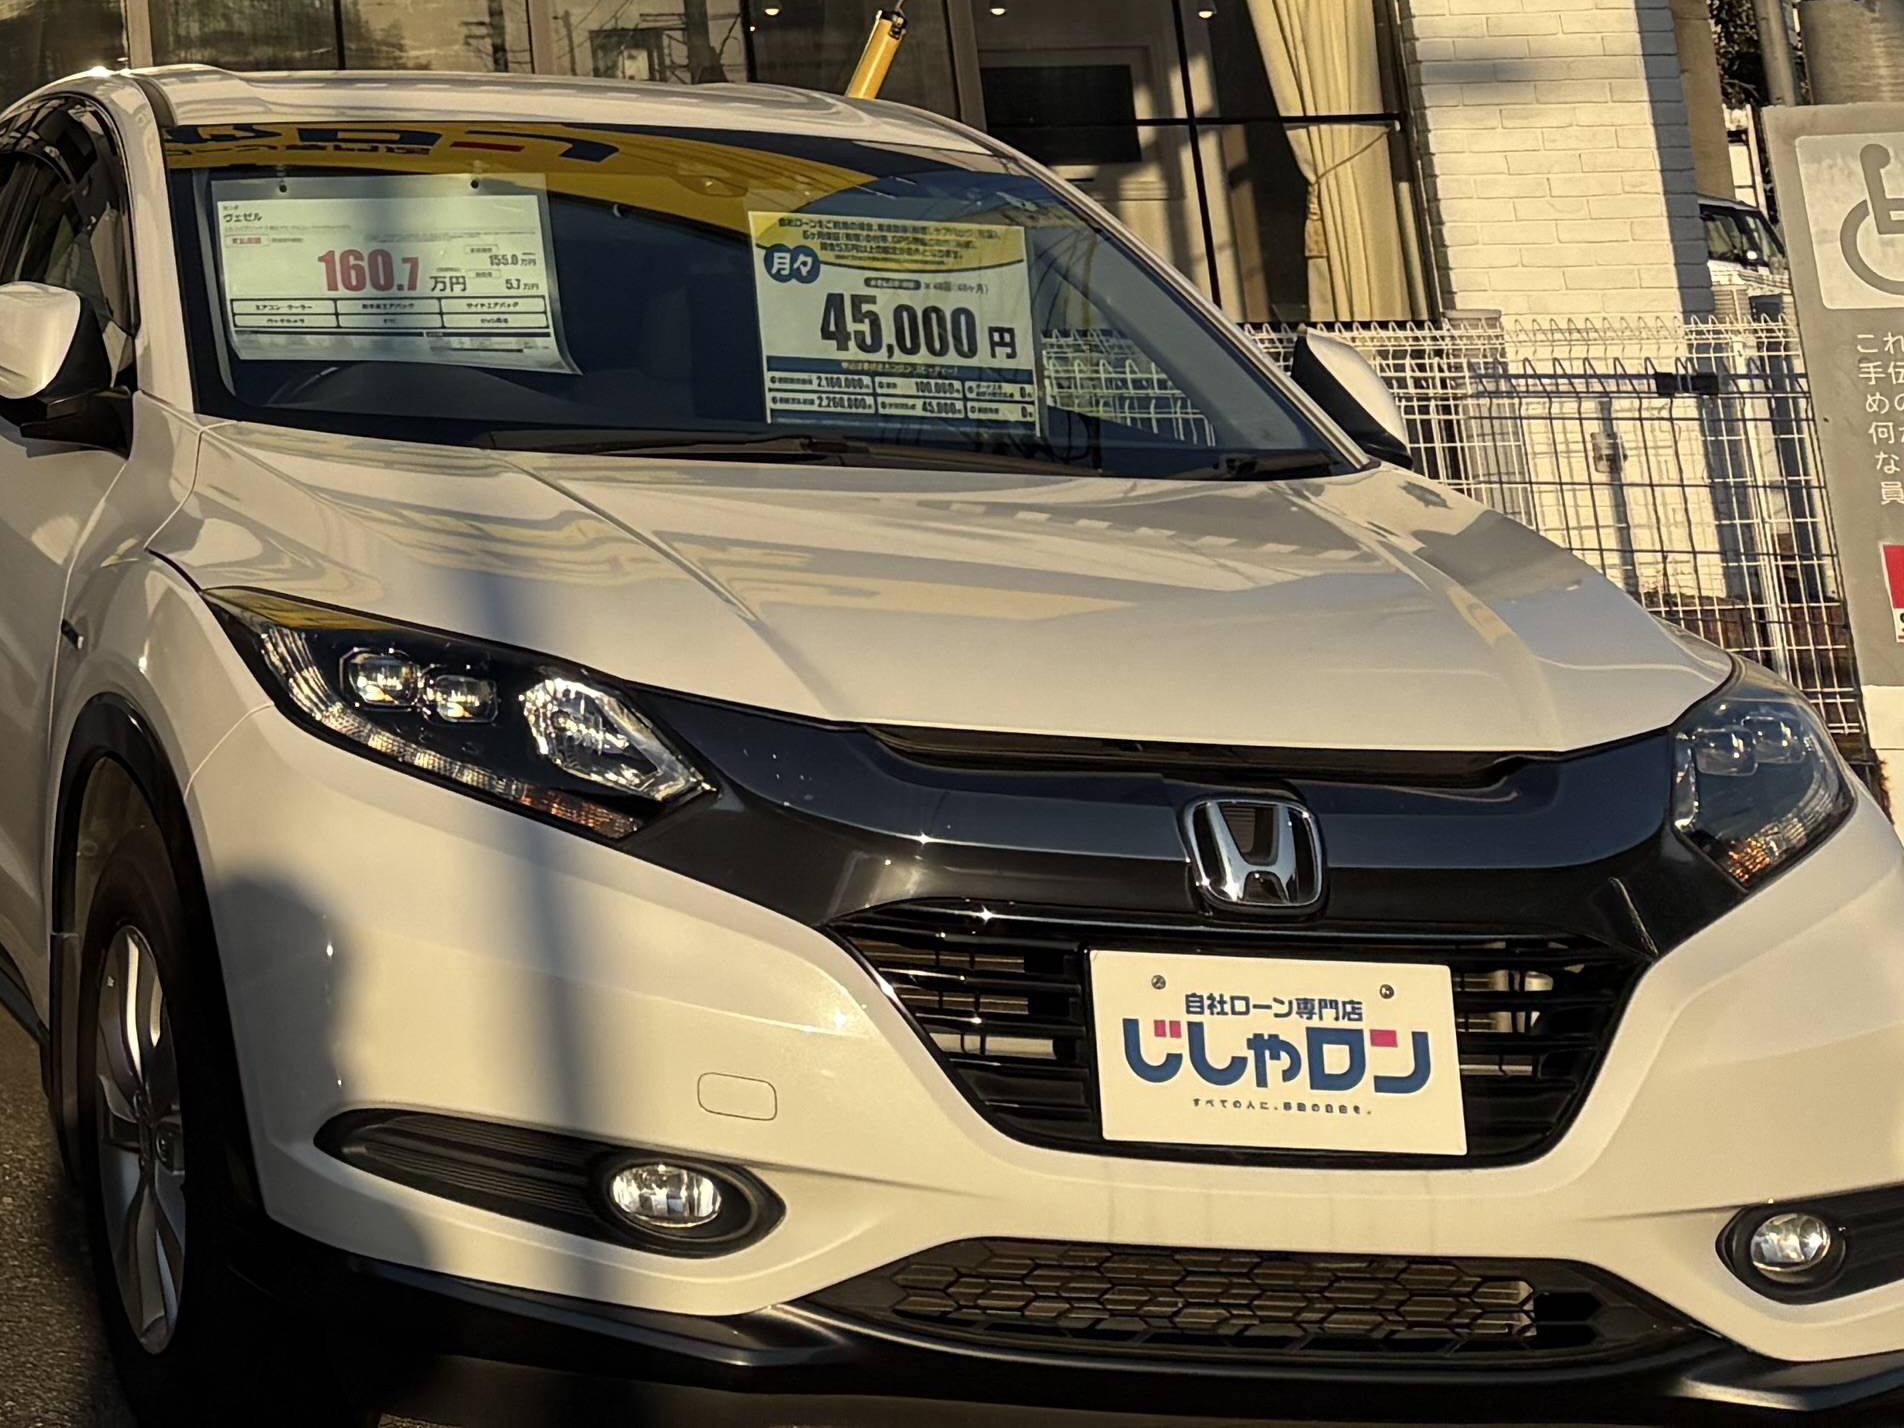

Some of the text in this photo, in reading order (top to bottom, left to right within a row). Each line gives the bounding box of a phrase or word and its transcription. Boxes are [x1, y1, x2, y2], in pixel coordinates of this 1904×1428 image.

[771, 252, 814, 277] 月々
[1185, 992, 1363, 1022] 自社ローン専門店
[1122, 1018, 1431, 1094] じしゃロン
